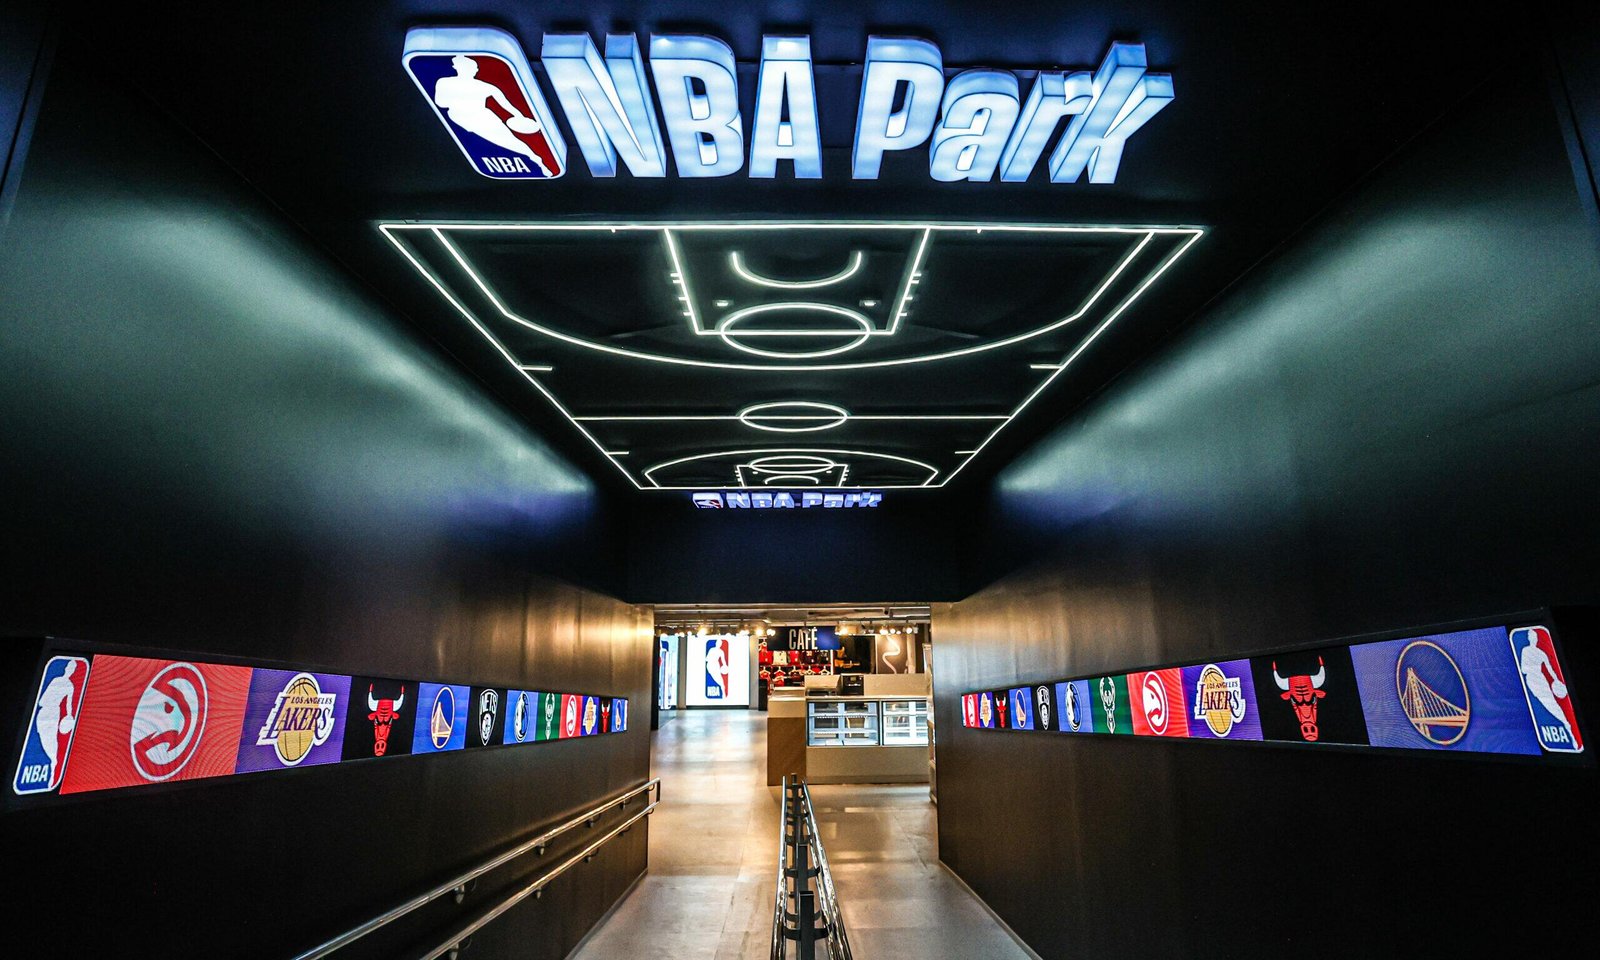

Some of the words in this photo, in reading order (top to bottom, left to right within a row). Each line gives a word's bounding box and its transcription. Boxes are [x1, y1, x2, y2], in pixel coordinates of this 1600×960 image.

[541, 32, 822, 178] NBA
[852, 35, 1175, 184] Park
[482, 156, 532, 174] NBA
[726, 492, 795, 508] NBA
[802, 492, 882, 508] Park
[291, 696, 305, 704] LOS
[305, 697, 333, 705] ANGELES
[1198, 684, 1240, 718] LAKERS
[262, 696, 331, 740] LAKERS
[1541, 725, 1569, 744] NBA
[21, 764, 49, 784] NBA
